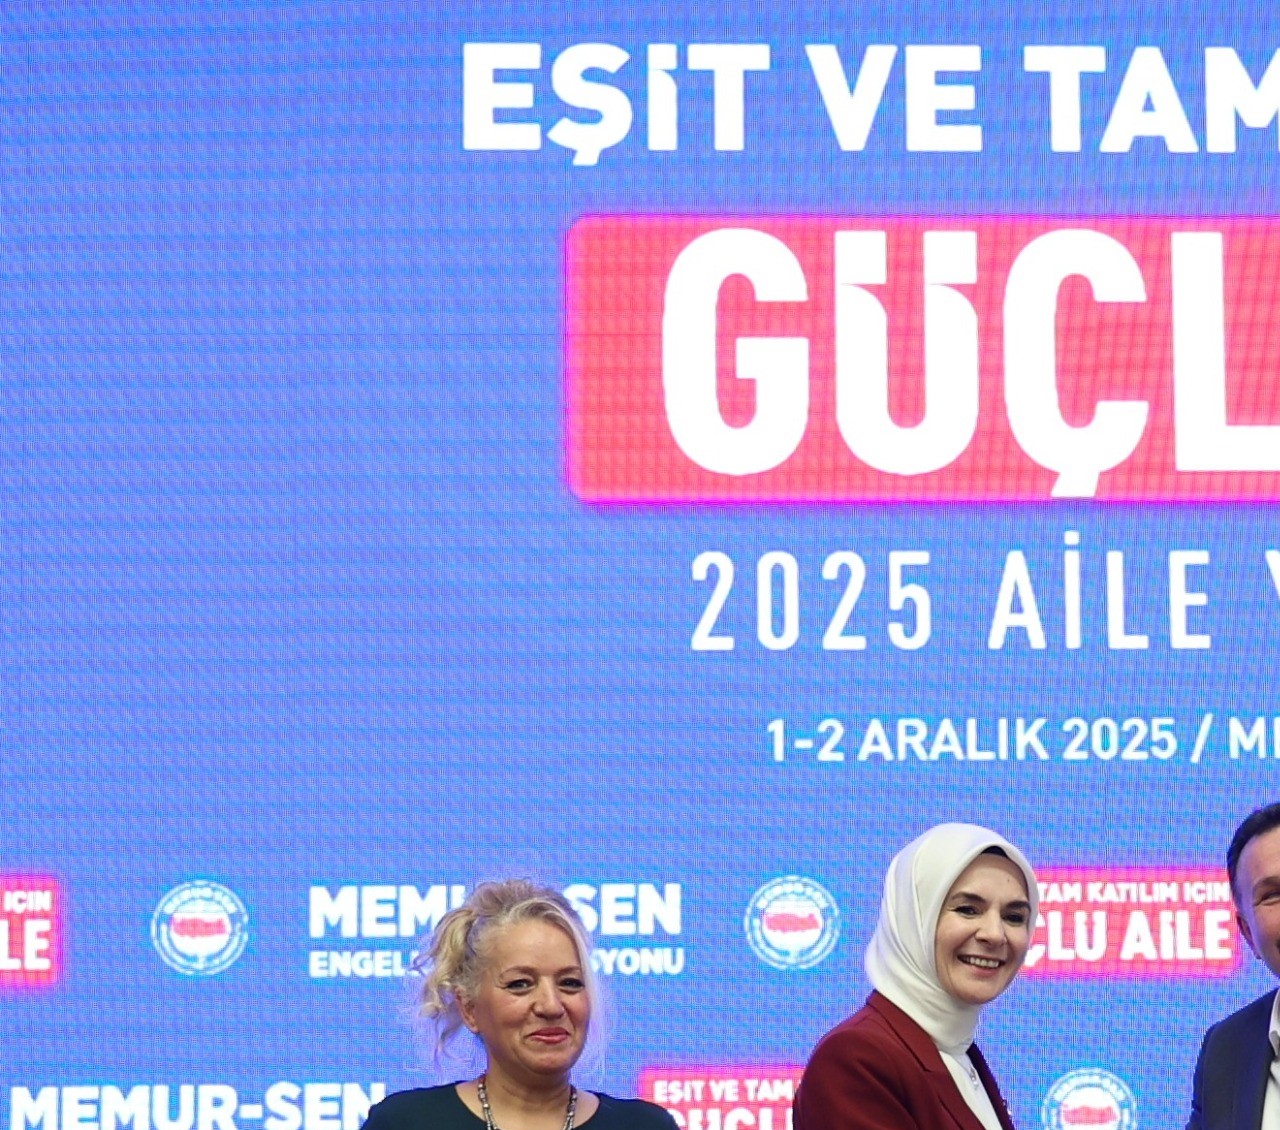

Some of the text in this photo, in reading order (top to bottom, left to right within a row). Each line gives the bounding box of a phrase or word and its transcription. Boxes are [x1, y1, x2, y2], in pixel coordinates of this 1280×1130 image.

[463, 43, 770, 165] EŞİT
[806, 45, 982, 152] VE
[692, 551, 931, 651] 2025
[989, 531, 1211, 649] AİLE
[768, 720, 844, 761] 1-2
[859, 718, 1048, 760] ARALIK
[1064, 718, 1176, 760] 2025
[1191, 715, 1212, 762] /
[1087, 882, 1178, 903] KATILIM
[0, 919, 51, 970] LE
[710, 1079, 738, 1102] VE
[745, 1079, 793, 1101] TAM
